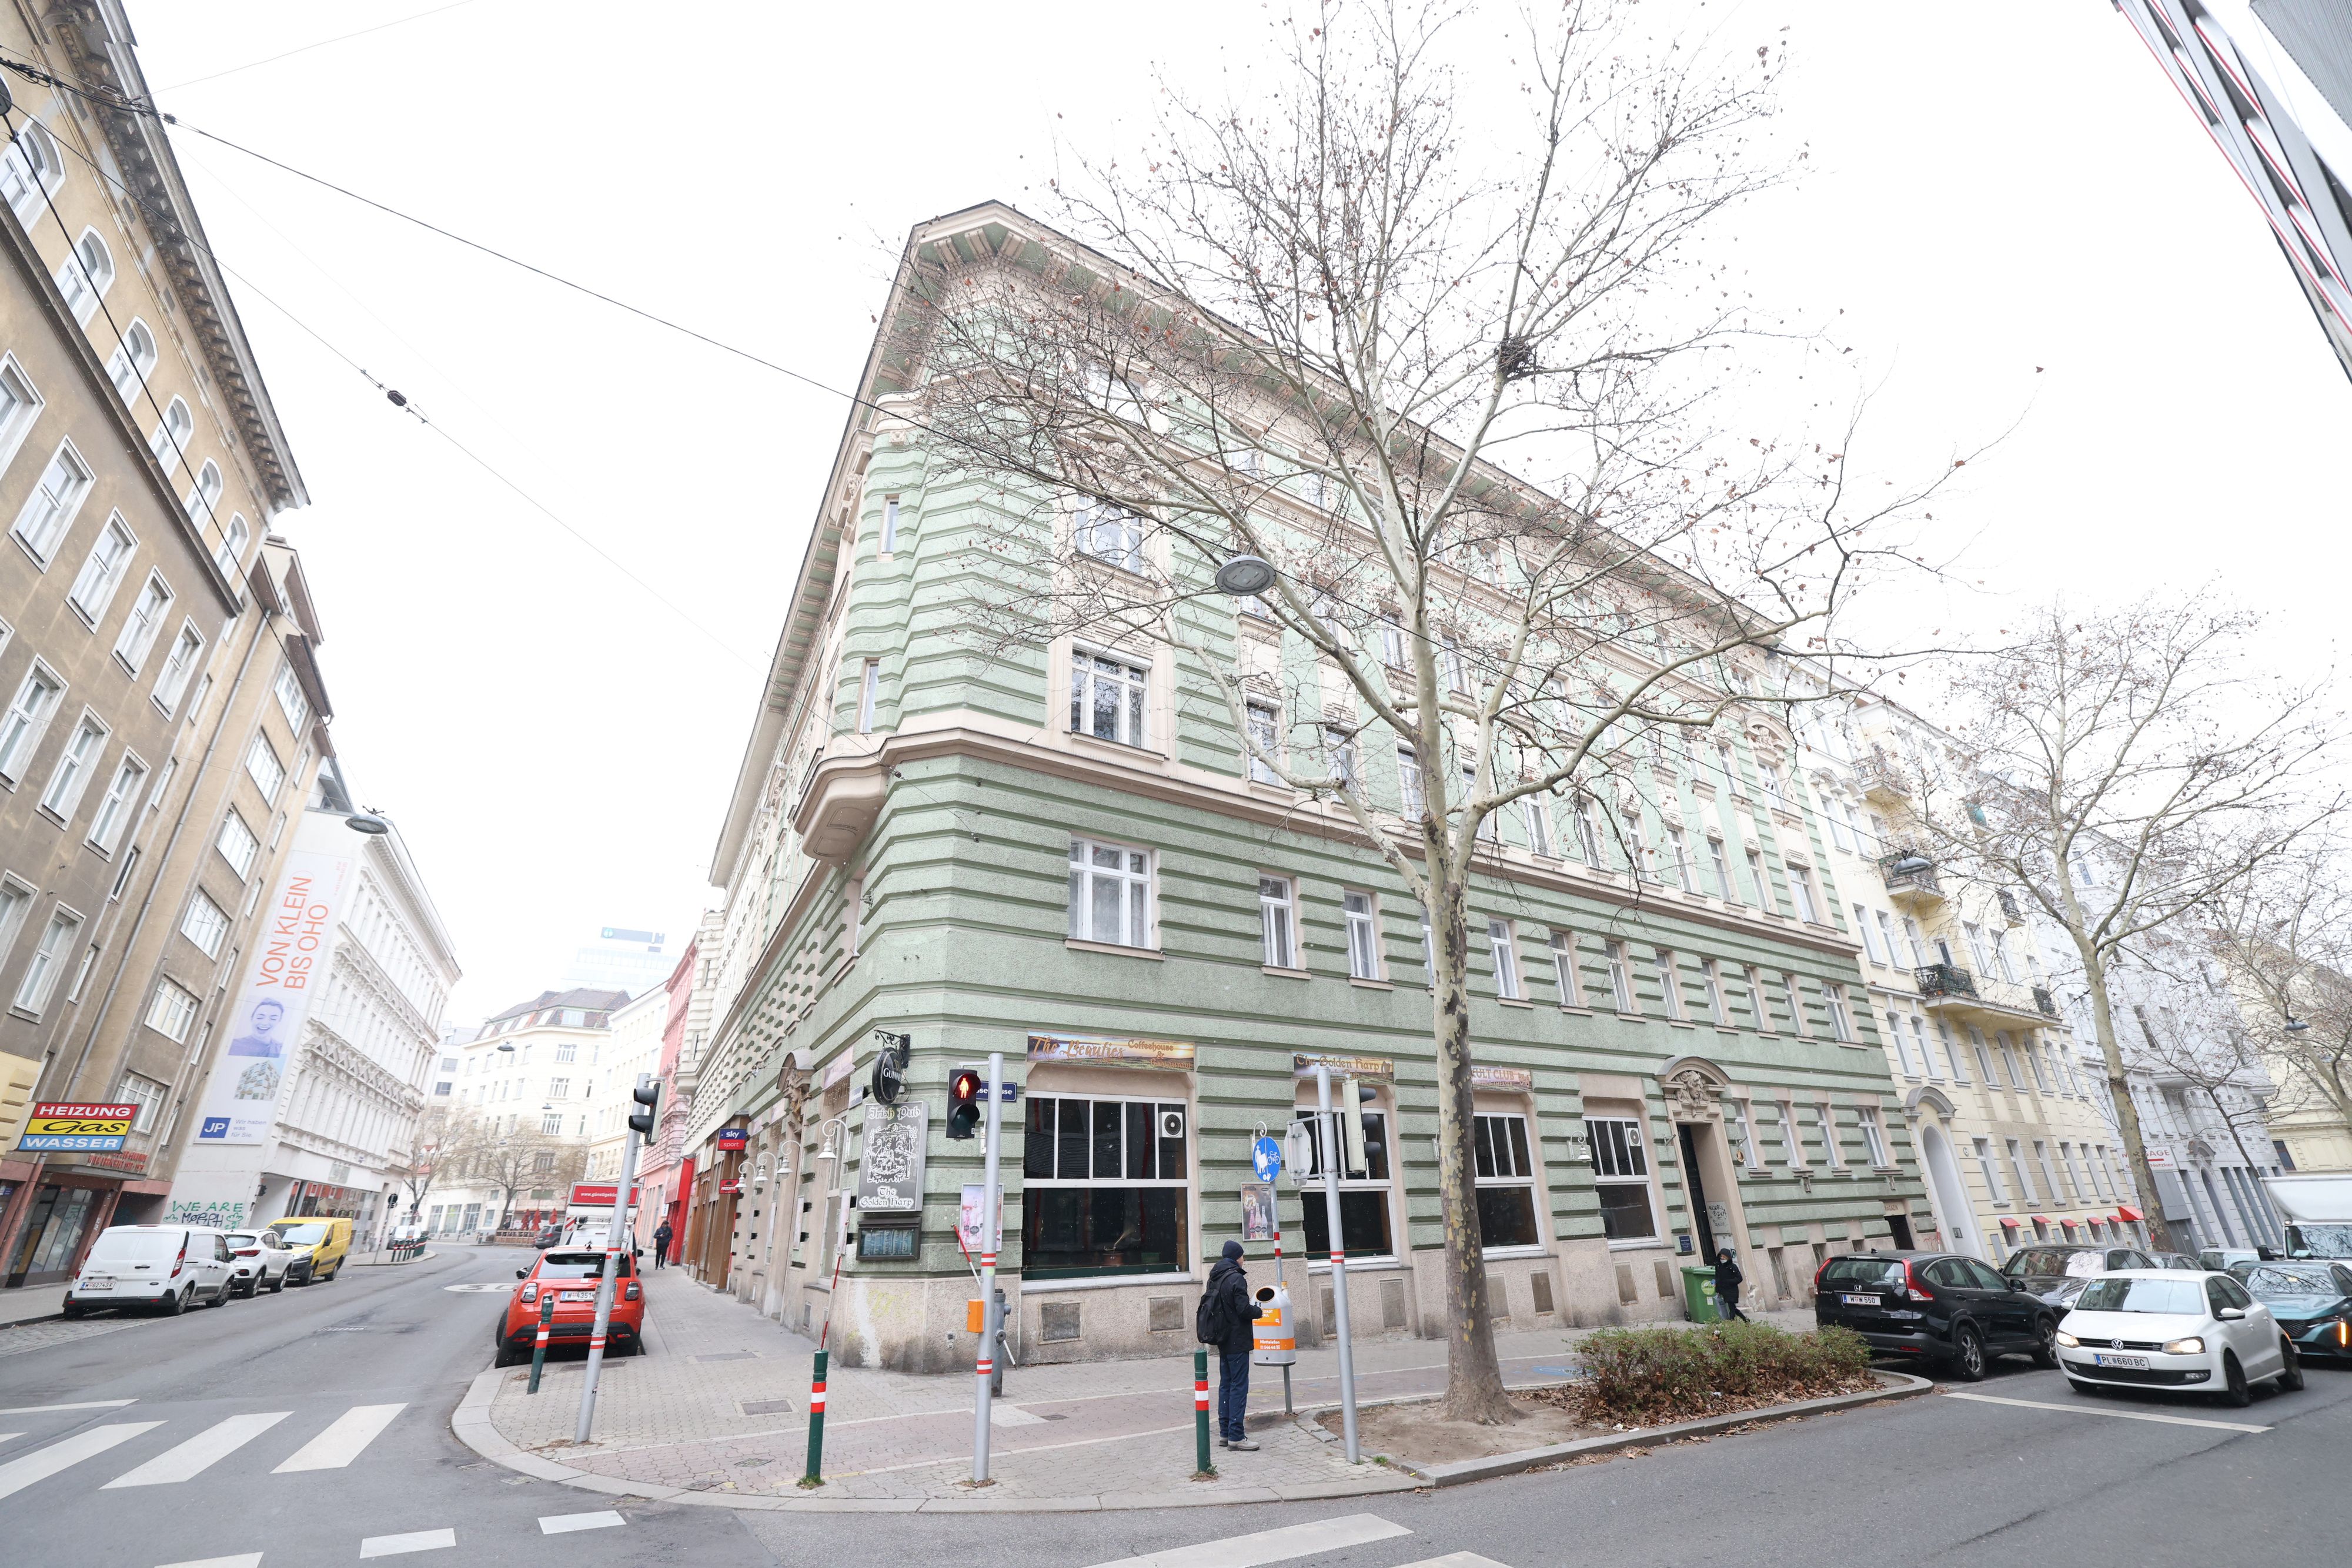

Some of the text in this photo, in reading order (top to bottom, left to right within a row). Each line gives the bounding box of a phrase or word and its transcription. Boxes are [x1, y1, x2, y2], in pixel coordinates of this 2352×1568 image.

[256, 877, 312, 986] VON KLEIN
[283, 904, 328, 989] BIS OHO
[1030, 1035, 1058, 1058] The
[1128, 1039, 1174, 1052] Coffeehouse
[1157, 1051, 1164, 1059] &
[1295, 1054, 1379, 1073] The Golden Harp
[883, 1068, 901, 1082] GUINN
[1494, 1070, 1514, 1080] CLUB
[39, 1106, 131, 1116] HEIZUNG
[868, 1105, 921, 1120] Irish Pub
[43, 1120, 125, 1134] Gas
[204, 1122, 225, 1132] JP
[26, 1138, 118, 1148] WASSER
[878, 1186, 897, 1198] The
[172, 1201, 243, 1212] WE ARE
[860, 1196, 913, 1207] Golden Harp
